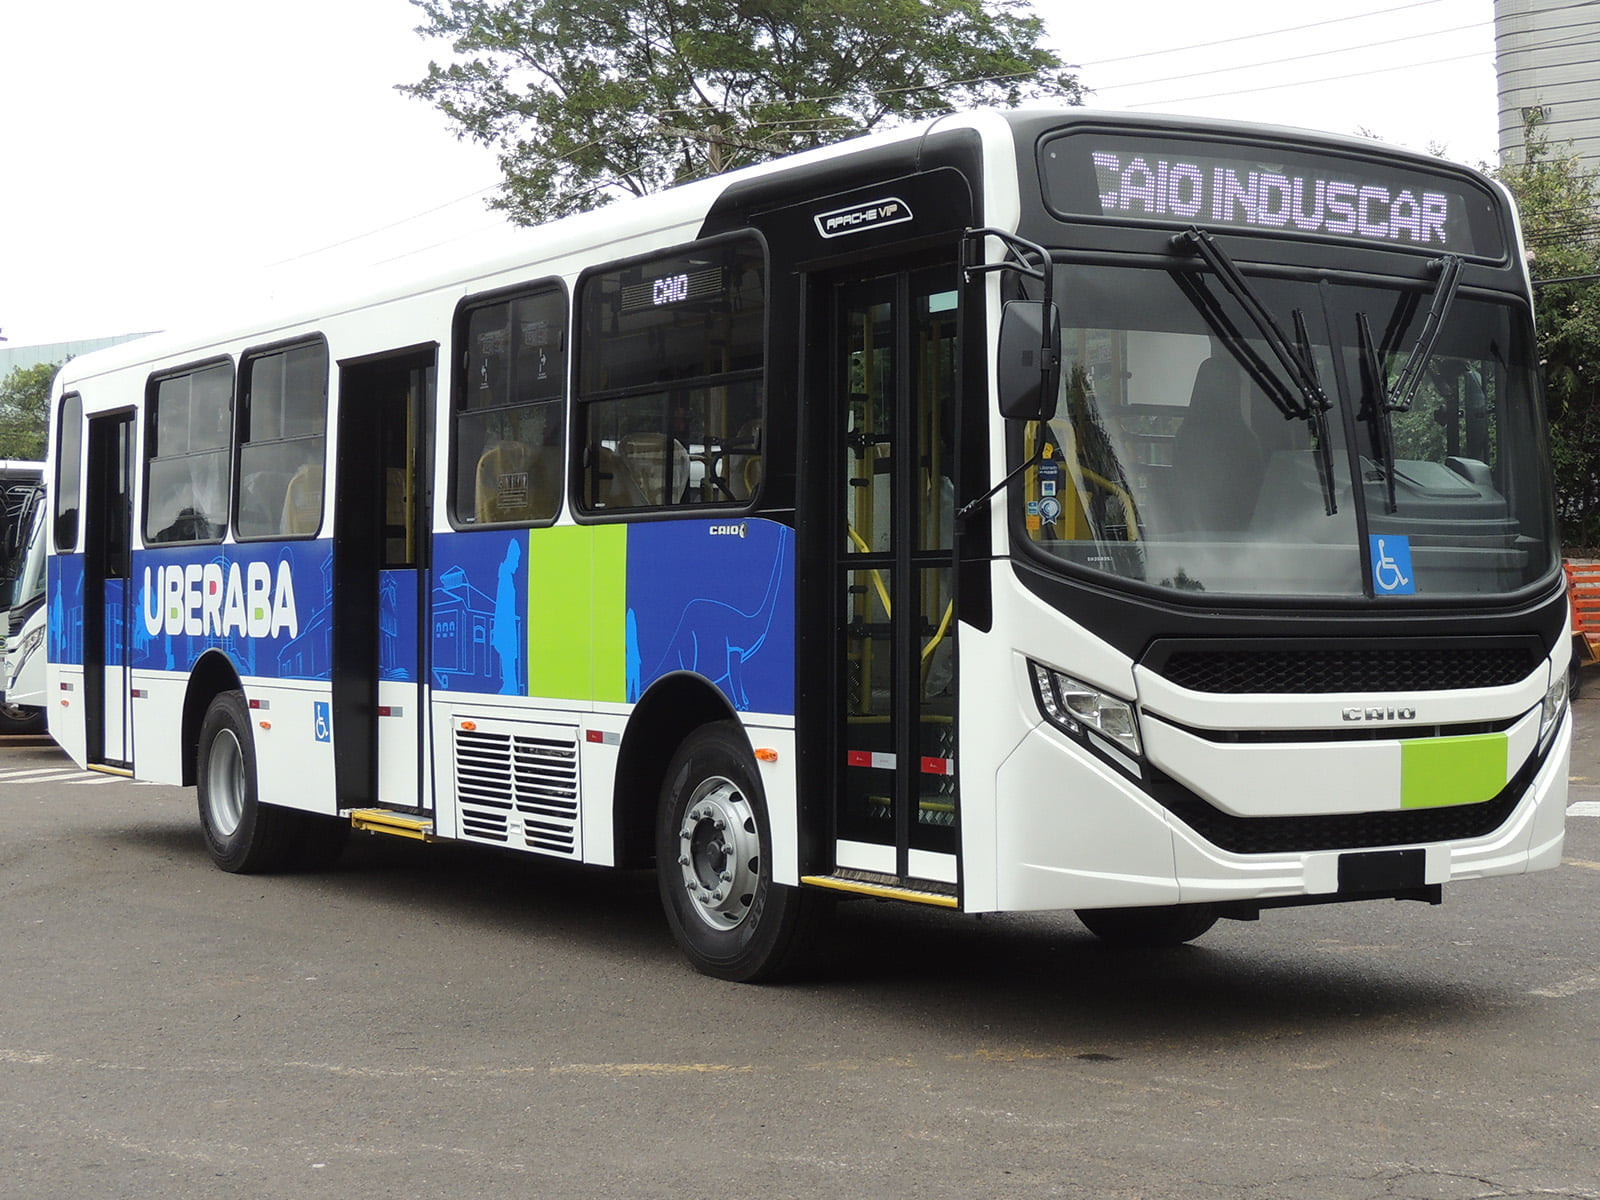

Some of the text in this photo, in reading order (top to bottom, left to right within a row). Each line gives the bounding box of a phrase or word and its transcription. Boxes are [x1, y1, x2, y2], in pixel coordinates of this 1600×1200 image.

[826, 203, 898, 230] APACHE VIP
[1212, 167, 1448, 244] INDUSCAR
[653, 274, 688, 305] CAIO
[709, 525, 739, 535] CAIO
[144, 560, 298, 640] UBERABA
[1342, 706, 1416, 721] CAIO
